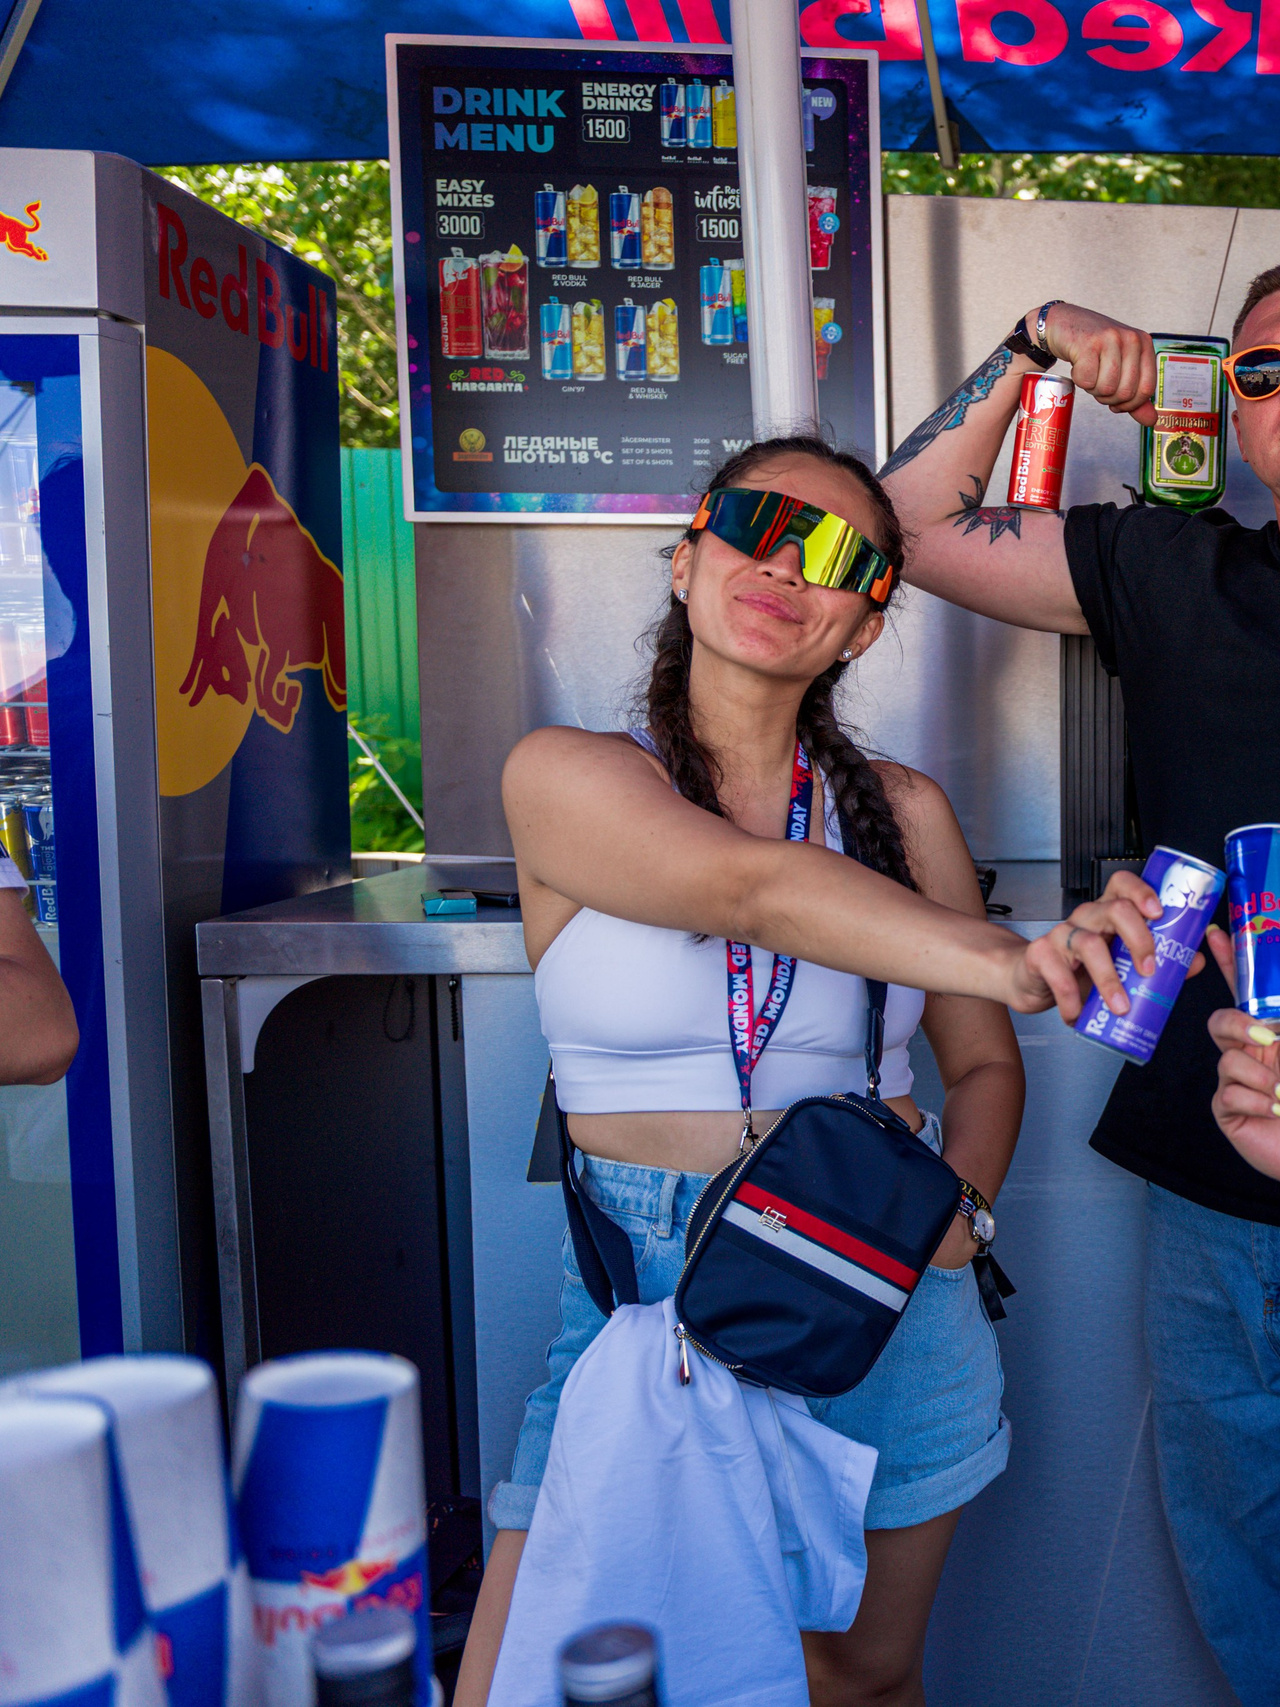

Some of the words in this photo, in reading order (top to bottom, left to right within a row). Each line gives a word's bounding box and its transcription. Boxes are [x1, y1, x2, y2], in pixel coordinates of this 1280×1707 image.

[582, 82, 657, 98] ENERGY
[432, 86, 567, 118] DRINK
[582, 97, 653, 112] DRINKS
[811, 96, 833, 108] NEW
[433, 122, 555, 153] MENU
[586, 118, 626, 139] 1500
[436, 179, 485, 193] EASY
[436, 193, 495, 208] MIXES
[694, 185, 741, 212] infusi
[439, 215, 481, 236] 3000
[700, 218, 739, 238] 1500
[157, 201, 249, 336] Red
[256, 257, 328, 374] Bull
[568, 274, 588, 282] BULL
[469, 367, 505, 380] RED
[451, 381, 523, 393] MARGARITA
[646, 387, 666, 395] BULL
[1182, 398, 1193, 408] 56
[503, 436, 599, 451] ЛЕДЯНЫЕ
[1026, 423, 1069, 448] RED
[504, 450, 566, 464] ШОТЫ
[570, 451, 589, 464] 18
[1025, 441, 1055, 453] EDITION
[1018, 449, 1031, 476] Bull
[1014, 476, 1027, 502] Red
[797, 742, 809, 769] RE
[790, 802, 807, 842] NDAY
[39, 873, 54, 898] Bll
[45, 897, 57, 920] Red
[731, 943, 747, 966] ED
[1115, 957, 1133, 982] ull
[763, 954, 793, 1021] MONDA
[733, 974, 749, 1054] MONDAY
